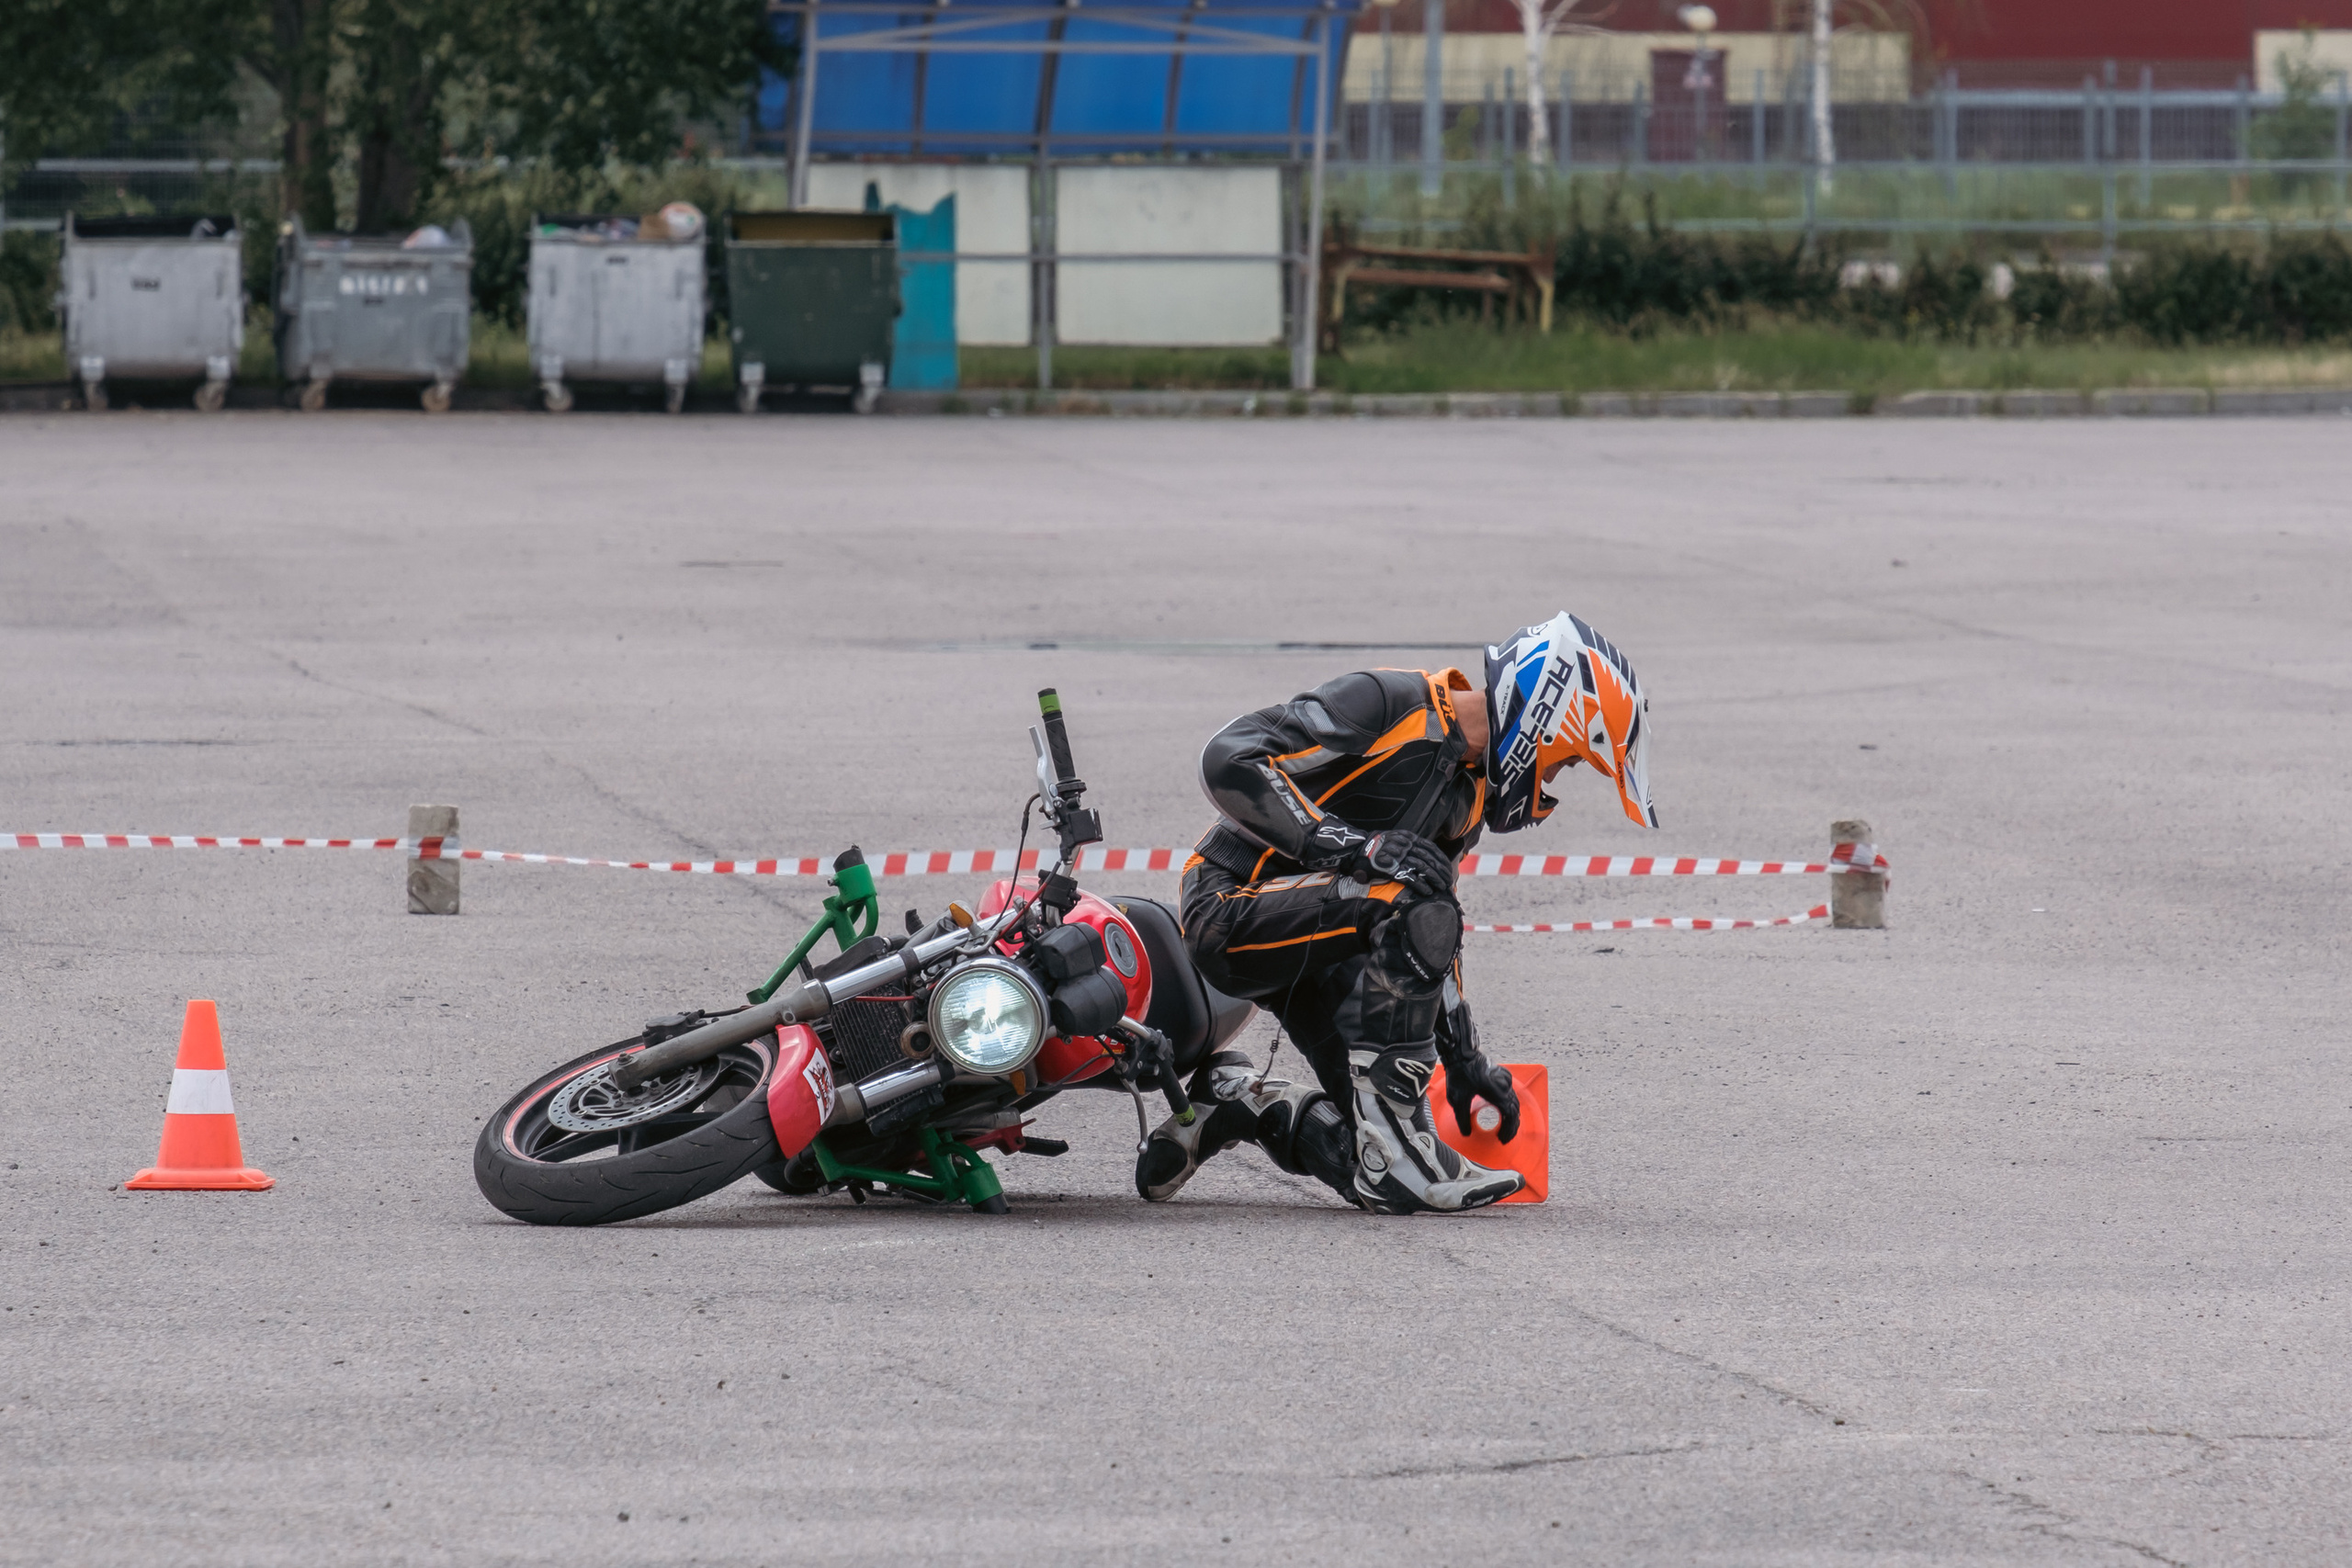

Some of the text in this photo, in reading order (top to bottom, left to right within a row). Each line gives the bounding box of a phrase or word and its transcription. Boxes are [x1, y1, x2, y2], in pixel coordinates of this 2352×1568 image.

[1500, 683, 1510, 715] X-TRACK
[1500, 655, 1576, 797] ACERBIS
[1256, 762, 1312, 826] BÜSE
[1364, 839, 1376, 855] SP
